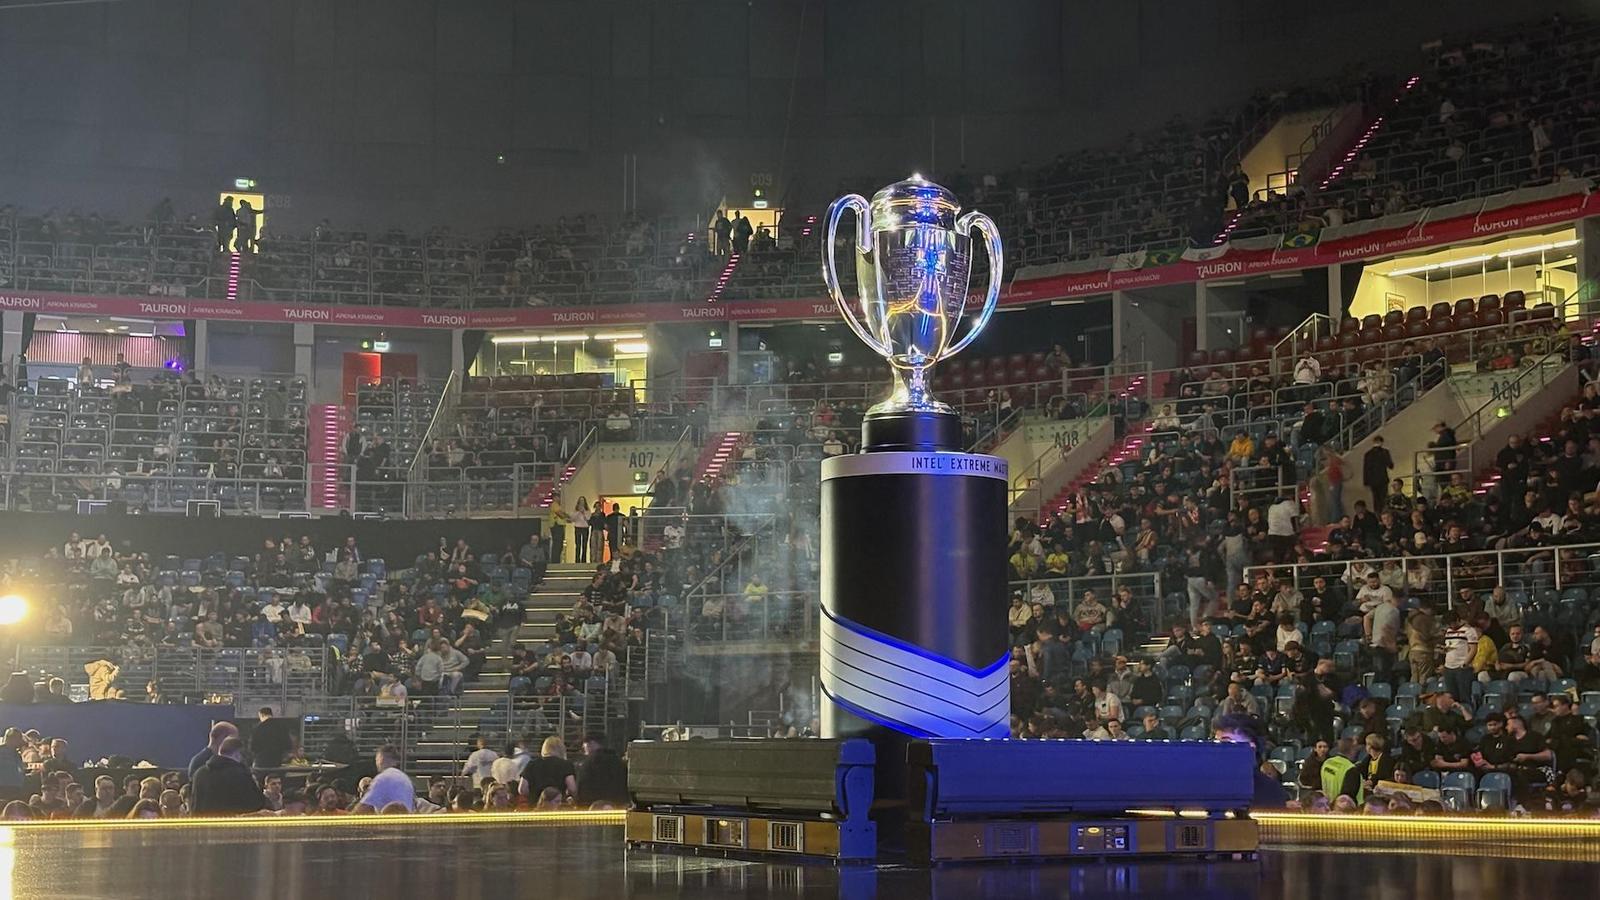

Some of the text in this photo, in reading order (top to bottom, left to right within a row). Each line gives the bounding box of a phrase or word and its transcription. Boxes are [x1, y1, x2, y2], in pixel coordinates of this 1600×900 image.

[1196, 261, 1242, 275] TAURON
[0, 296, 40, 308] AURON
[139, 303, 186, 314] TAURON
[283, 308, 329, 320] TAURON
[681, 307, 725, 318] TAURON
[421, 314, 466, 325] TAURON
[552, 312, 595, 322] TAURON
[1054, 430, 1079, 450] A08
[628, 452, 654, 468] A07
[950, 458, 990, 472] EXTREME
